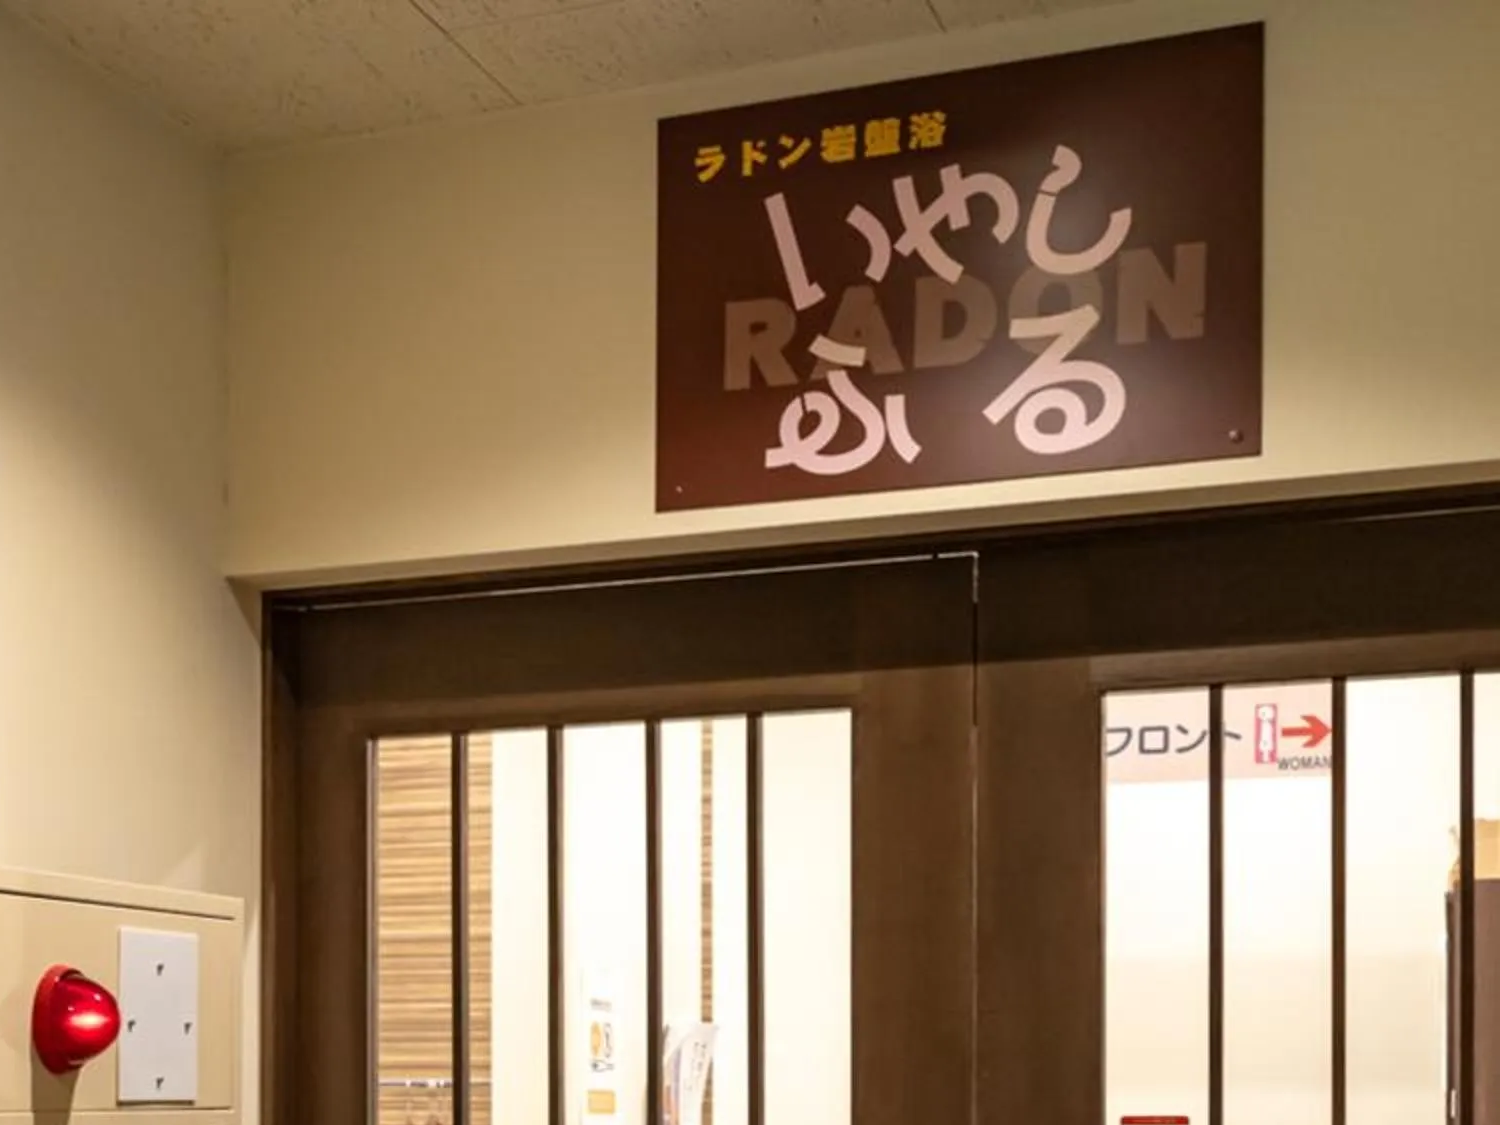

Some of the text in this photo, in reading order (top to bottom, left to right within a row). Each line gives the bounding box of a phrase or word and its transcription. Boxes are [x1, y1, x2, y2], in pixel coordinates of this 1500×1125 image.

[694, 111, 948, 183] ラドン岩盤浴
[764, 144, 1132, 311] いやし
[723, 242, 1208, 391] RADON
[764, 303, 1127, 475] ふる
[1106, 723, 1242, 757] フロン
[1277, 755, 1332, 770] WOMAN
